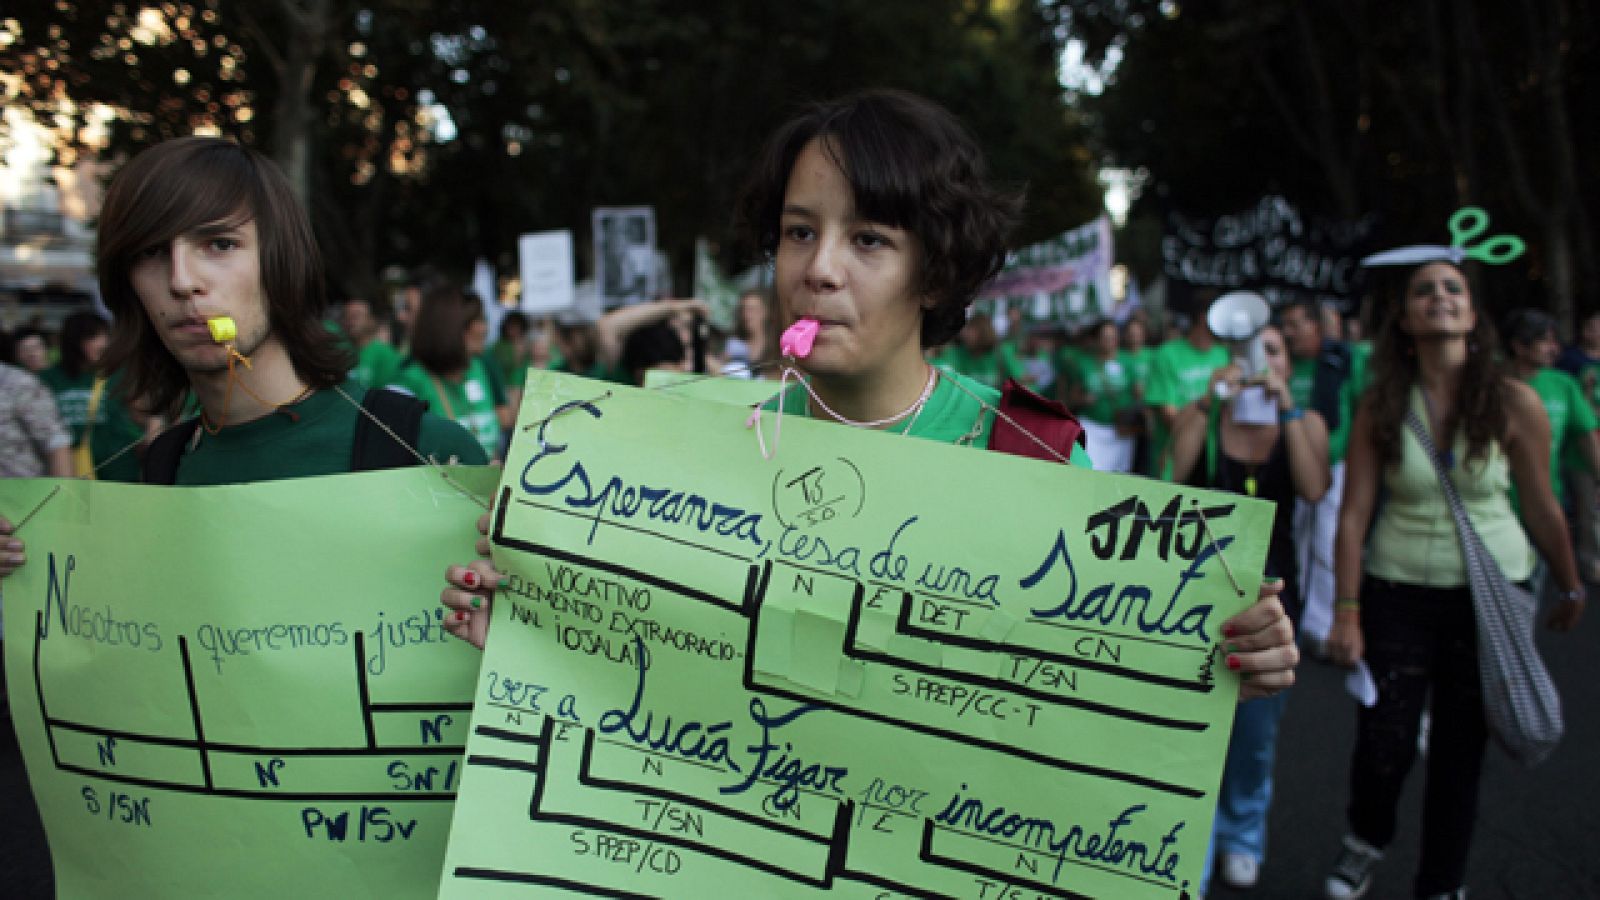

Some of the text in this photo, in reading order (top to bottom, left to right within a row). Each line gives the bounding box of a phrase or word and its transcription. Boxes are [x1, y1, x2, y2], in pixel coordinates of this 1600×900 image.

[1085, 494, 1236, 562] JMJ
[545, 562, 651, 613] VOCATIVO
[792, 573, 814, 596] N
[869, 515, 918, 582] de
[915, 563, 1001, 606] una
[1019, 527, 1236, 643] Santa
[40, 551, 449, 675] Nosotros queremos justi
[919, 600, 971, 631] DET
[1074, 637, 1121, 663] CN
[1009, 655, 1078, 692] T/SN
[505, 711, 521, 726] N
[487, 670, 549, 711] ver
[557, 694, 580, 721] a
[598, 632, 742, 774] Lucía
[858, 777, 930, 829] por
[935, 782, 1190, 889] incompetente.
[641, 756, 663, 776] N
[634, 799, 704, 838] T/SN
[1014, 851, 1039, 876] N
